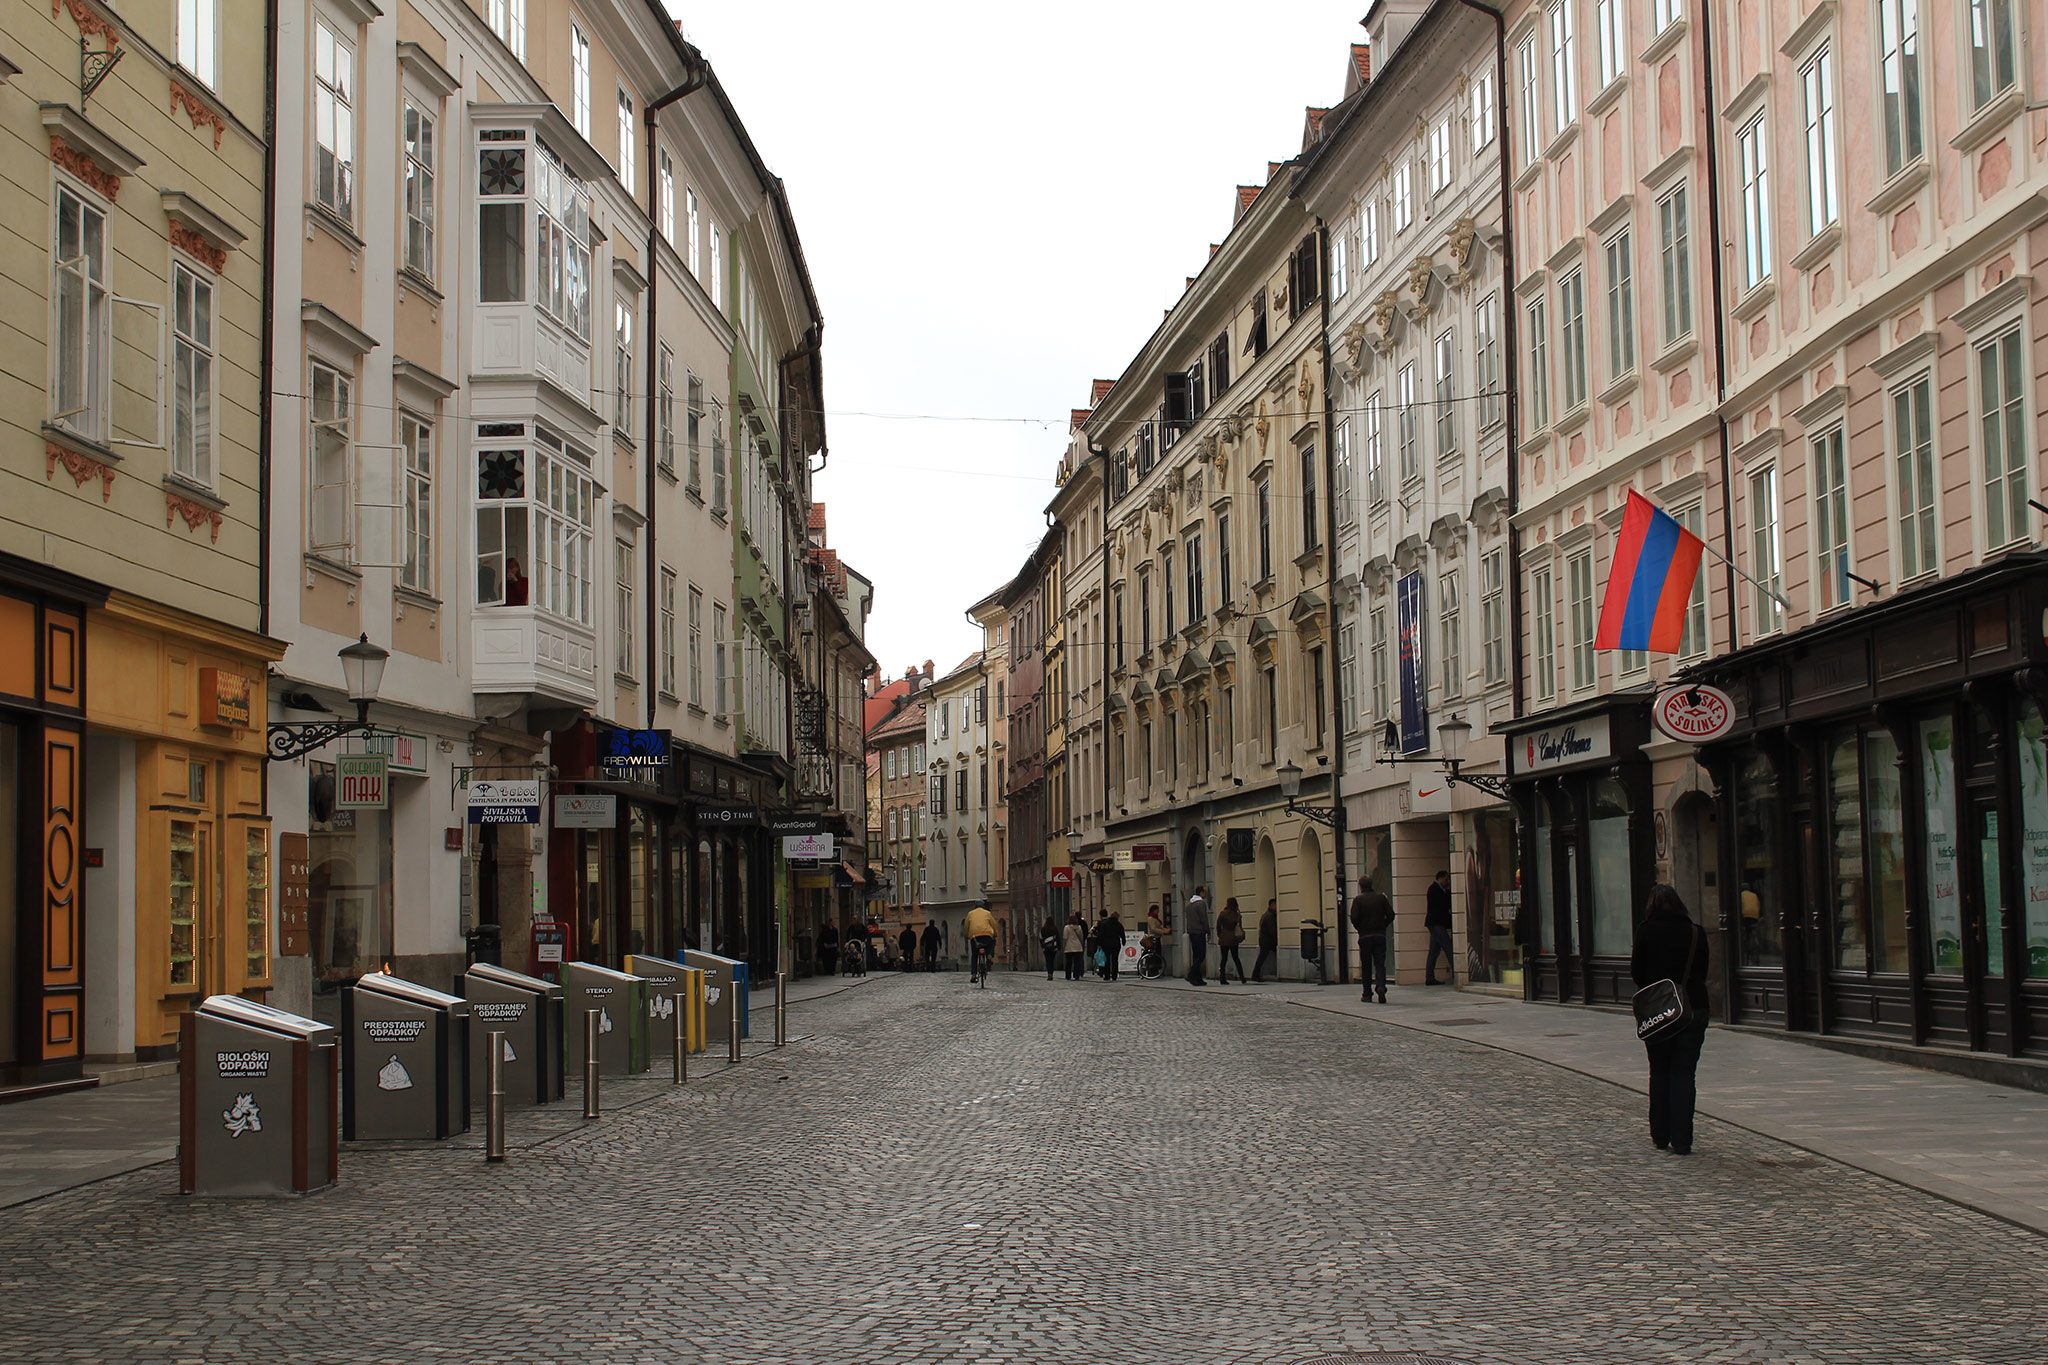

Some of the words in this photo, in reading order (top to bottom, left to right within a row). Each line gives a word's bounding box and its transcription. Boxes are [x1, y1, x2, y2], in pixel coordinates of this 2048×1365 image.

[1669, 694, 1723, 715] PIRSKE
[1675, 715, 1716, 732] SOLINE
[603, 755, 669, 766] FREYWILLE
[343, 776, 381, 802] MAK
[482, 807, 527, 816] ŠIVILJSKA
[481, 815, 529, 823] POPRAVILA
[772, 821, 816, 830] AvantGarde
[473, 1003, 527, 1011] PREOSTANEK
[364, 1021, 426, 1029] PREOSTANEK
[1638, 1013, 1665, 1034] adidas
[370, 1028, 420, 1037] ODPADKOV
[217, 1050, 270, 1062] BIOLOŠKI
[219, 1061, 268, 1070] ODPADKI
